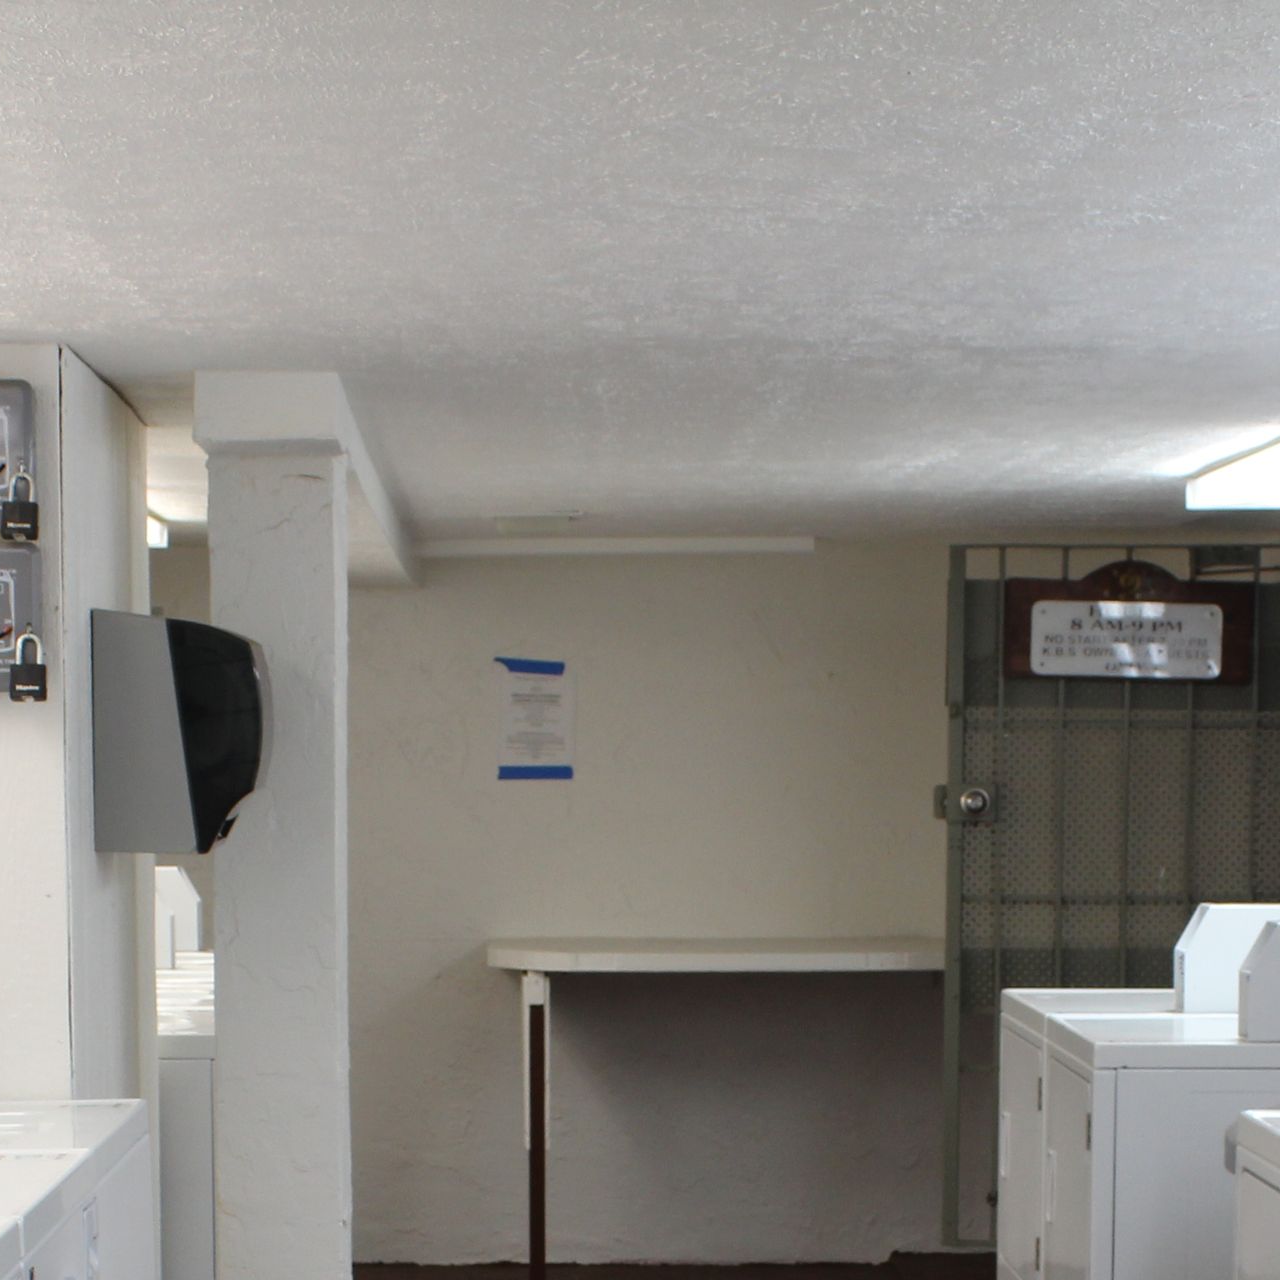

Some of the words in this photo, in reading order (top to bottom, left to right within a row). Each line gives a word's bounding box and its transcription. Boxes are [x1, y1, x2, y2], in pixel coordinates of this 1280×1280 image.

[1071, 619, 1082, 631] 8
[1152, 620, 1183, 633] PM
[1044, 634, 1064, 645] NO
